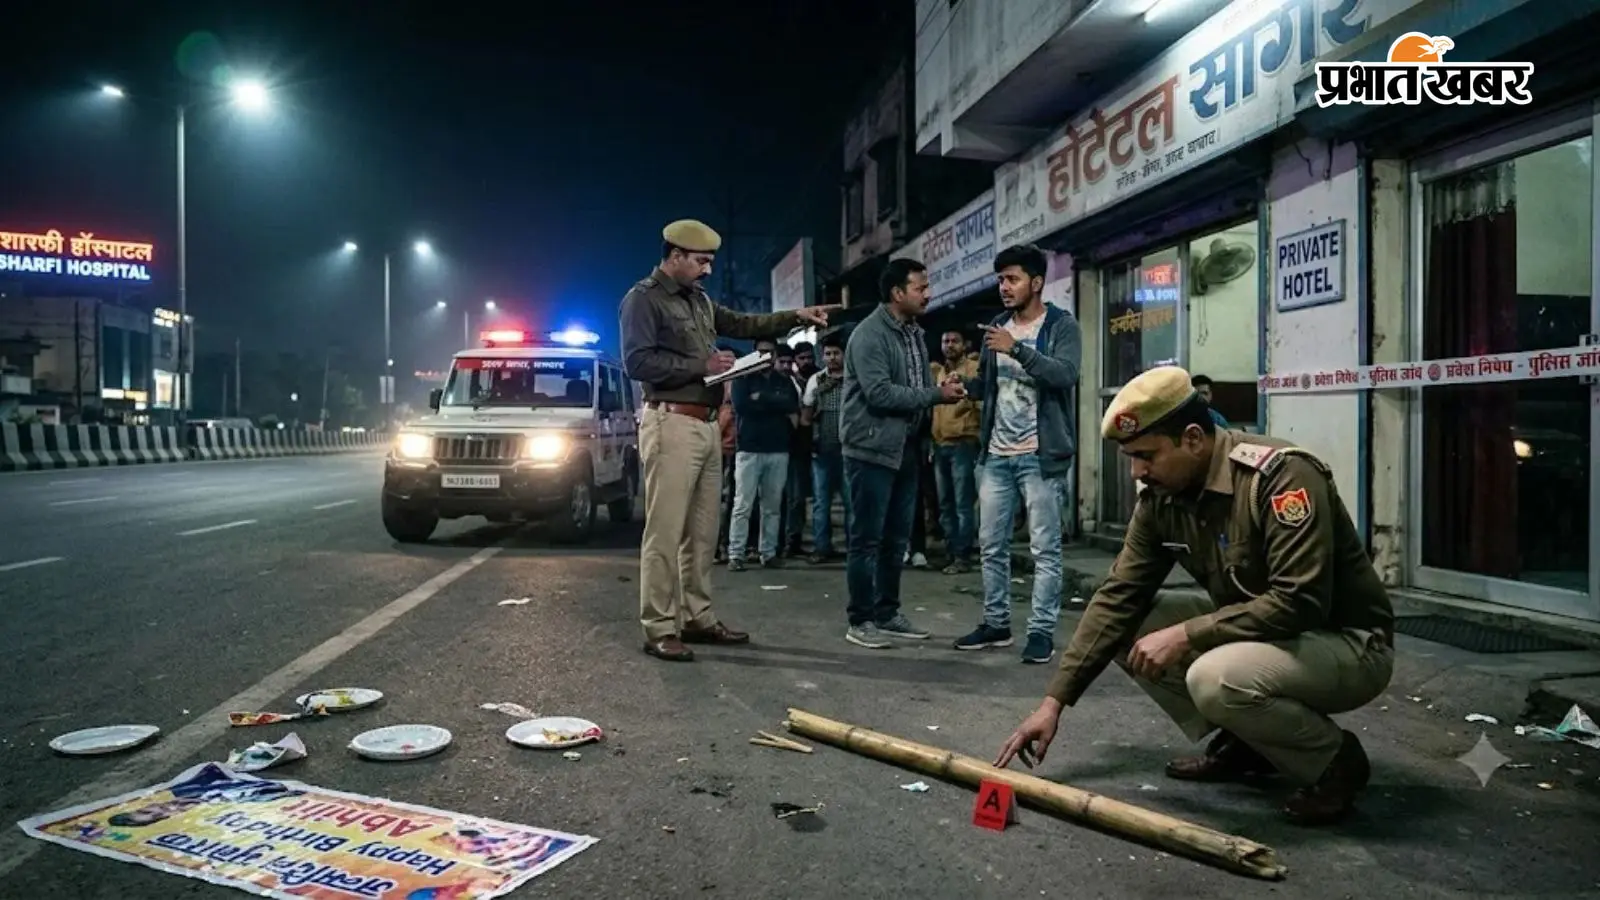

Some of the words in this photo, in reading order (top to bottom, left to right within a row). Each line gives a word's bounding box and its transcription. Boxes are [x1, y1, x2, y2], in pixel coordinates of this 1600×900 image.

[1278, 230, 1339, 269] PRIVATE
[67, 259, 150, 280] HOSPITAL
[1283, 266, 1333, 300] HOTEL
[983, 788, 1000, 813] A
[348, 841, 457, 875] Happy
